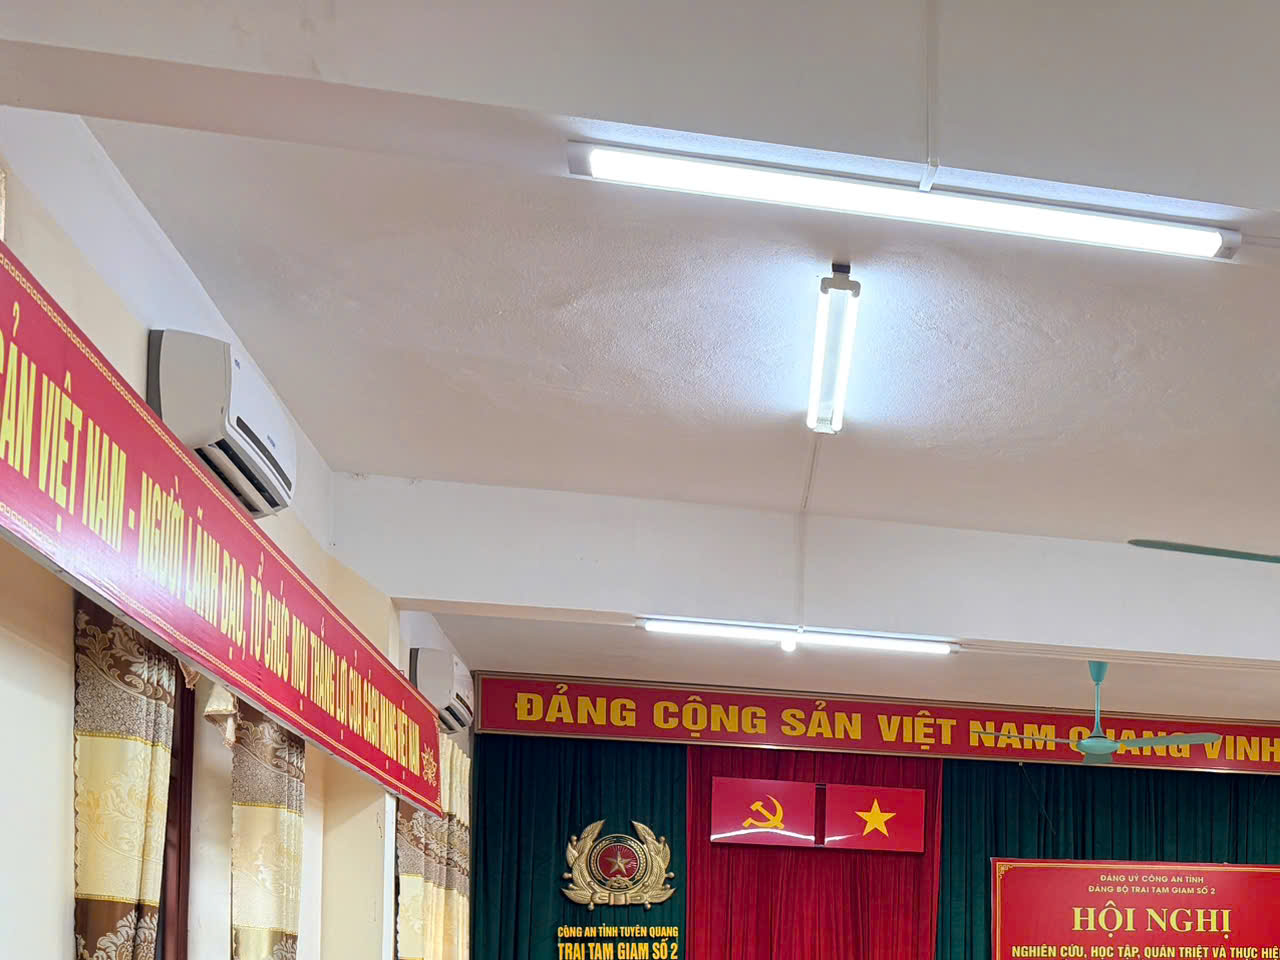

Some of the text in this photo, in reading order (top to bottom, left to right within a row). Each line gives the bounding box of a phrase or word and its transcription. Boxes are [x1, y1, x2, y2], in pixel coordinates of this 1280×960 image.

[38, 370, 83, 533] VIỆT
[82, 418, 127, 552] NAM
[128, 508, 135, 530] -
[137, 472, 185, 600] NGƯỜI
[185, 505, 220, 628] LÃNH
[220, 548, 246, 660] ĐẠO,
[250, 551, 265, 662] TỔ
[264, 580, 290, 682] CHỨC
[291, 614, 309, 711] MỌI
[310, 617, 336, 718] THẮNG
[514, 683, 637, 728] ĐẢNG
[653, 696, 768, 737] CỘNG
[781, 700, 863, 740] SẢN
[879, 710, 957, 750] VIỆT
[969, 720, 1057, 751] NAM
[1068, 726, 1191, 758] QANG
[1100, 873, 1126, 882] ĐẢNG
[1141, 873, 1169, 883] CÔNG
[1170, 875, 1183, 883] AN
[1088, 884, 1114, 893] ĐẢNG
[1210, 887, 1216, 895] 2
[1072, 900, 1233, 939] HỘI NGHỊ
[558, 923, 679, 938] CÔNG AN TỈNH TUYÊN QUANG
[617, 942, 649, 960] GIAM
[652, 938, 669, 960] SỐ
[670, 942, 678, 960] 2
[1011, 944, 1057, 958] NGHIÊN
[1060, 944, 1087, 959] CỨU,
[1090, 946, 1114, 960] HỌC
[1117, 944, 1141, 960] TẬP,
[1143, 944, 1176, 959] QUÁN
[1178, 945, 1209, 960] TRIỆT
[1212, 945, 1227, 958] VÀ
[1230, 947, 1259, 960] THỰC
